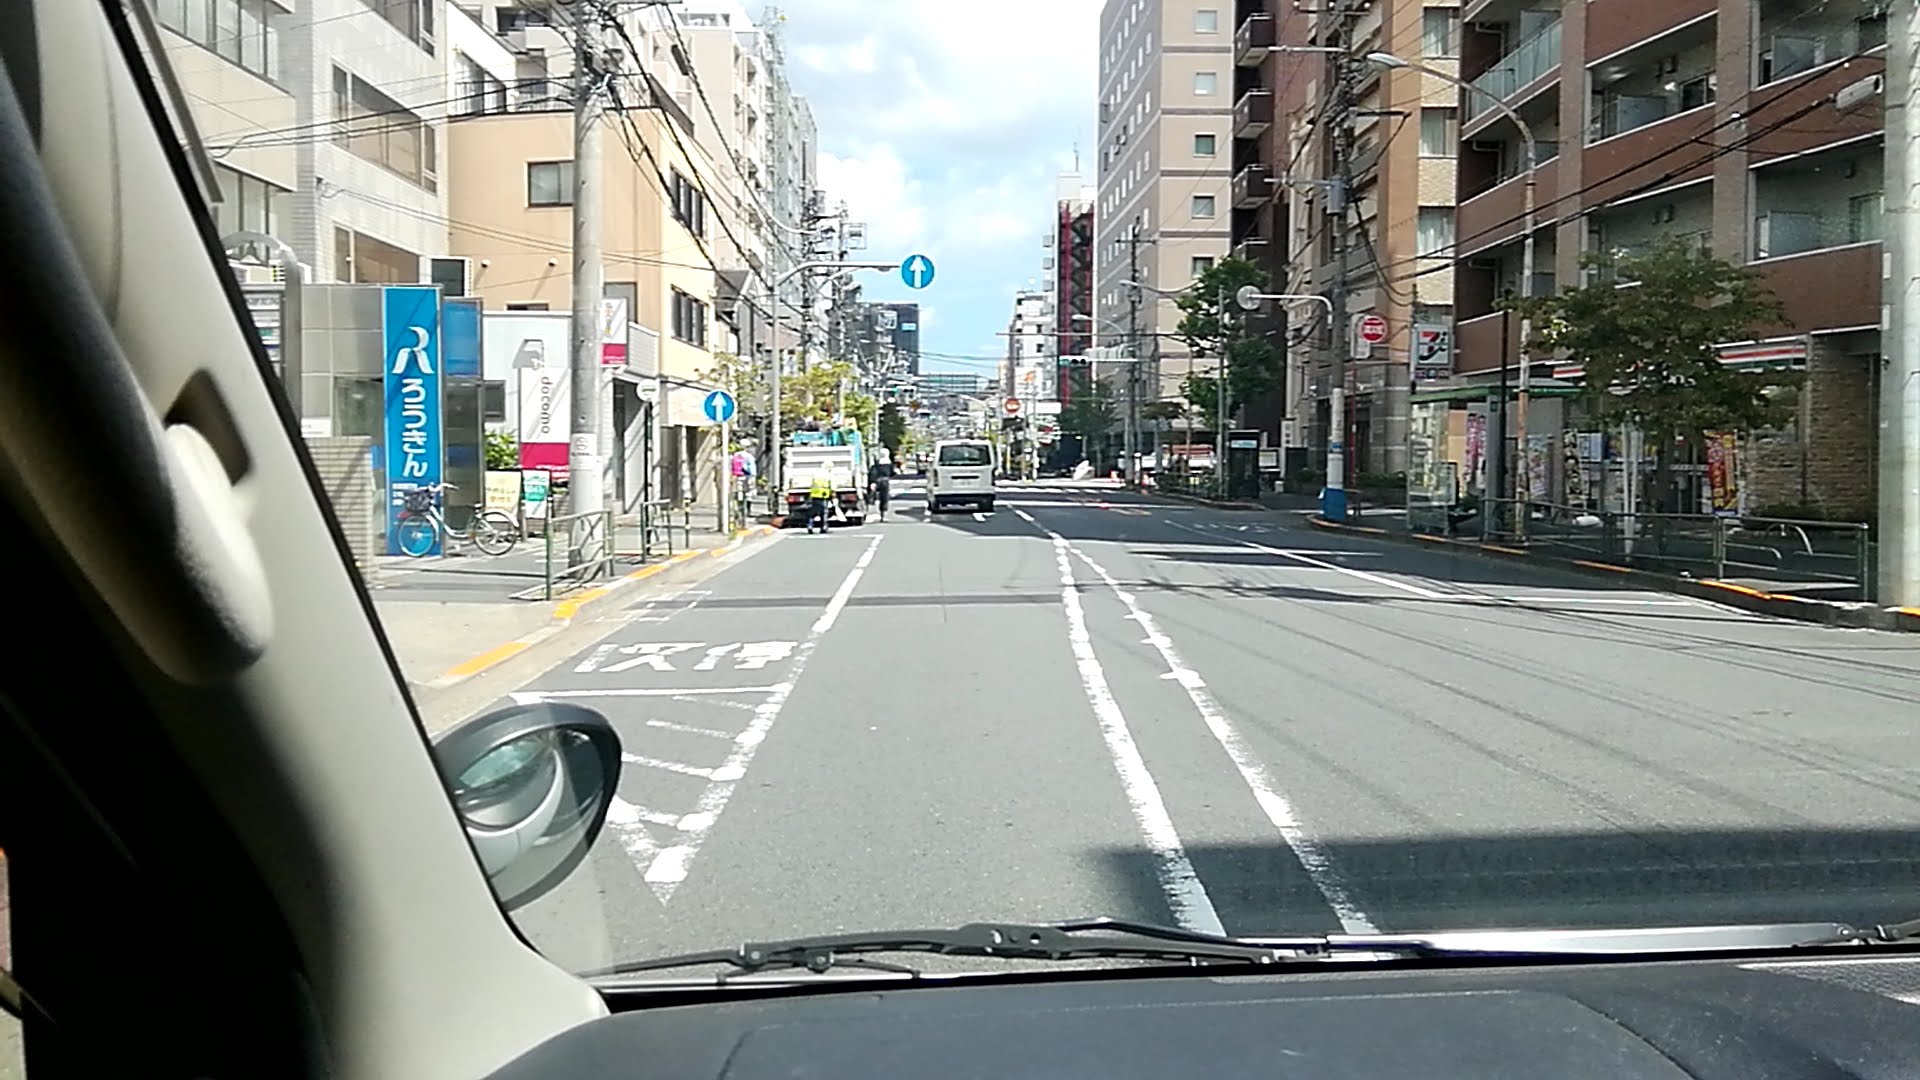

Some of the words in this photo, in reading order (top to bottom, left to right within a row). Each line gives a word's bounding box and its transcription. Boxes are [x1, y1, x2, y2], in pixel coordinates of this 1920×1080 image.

[401, 378, 429, 478] ろうきん
[541, 376, 554, 435] docomo
